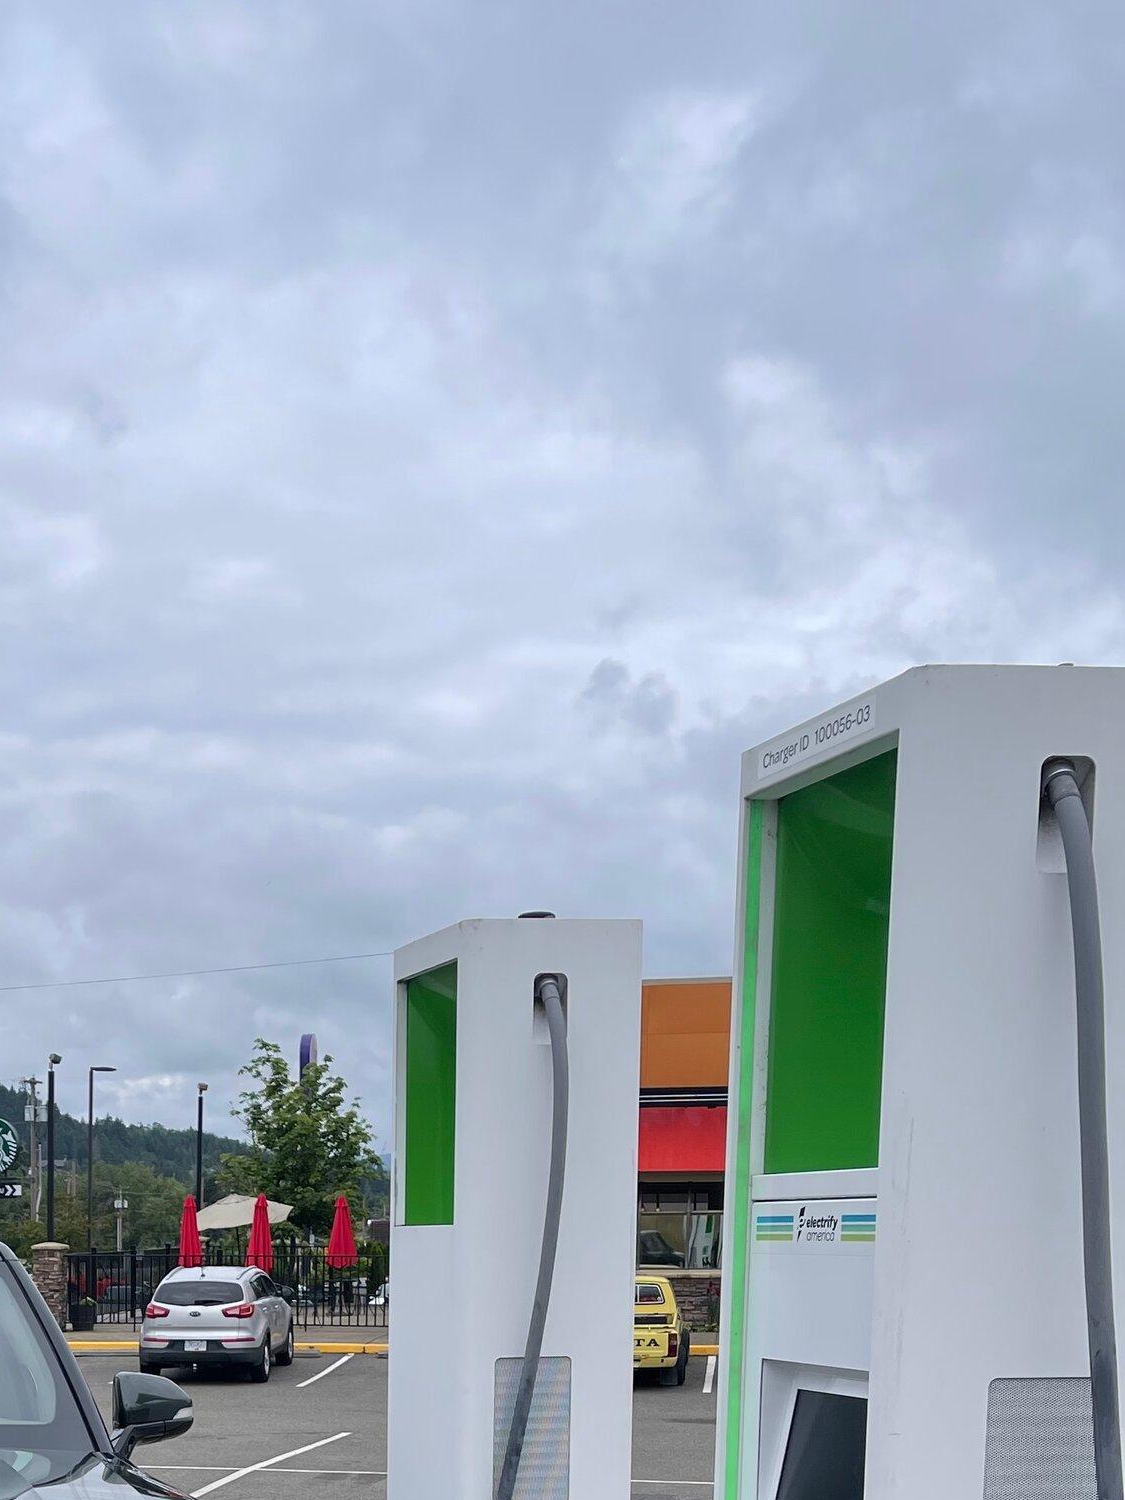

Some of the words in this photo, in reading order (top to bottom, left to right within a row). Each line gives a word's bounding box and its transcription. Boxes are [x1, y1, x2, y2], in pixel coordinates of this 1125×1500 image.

[762, 743, 799, 768] Charger
[799, 734, 809, 752] ID
[814, 705, 871, 744] 100056-03
[806, 1215, 838, 1231] electrify
[806, 1231, 835, 1242] america
